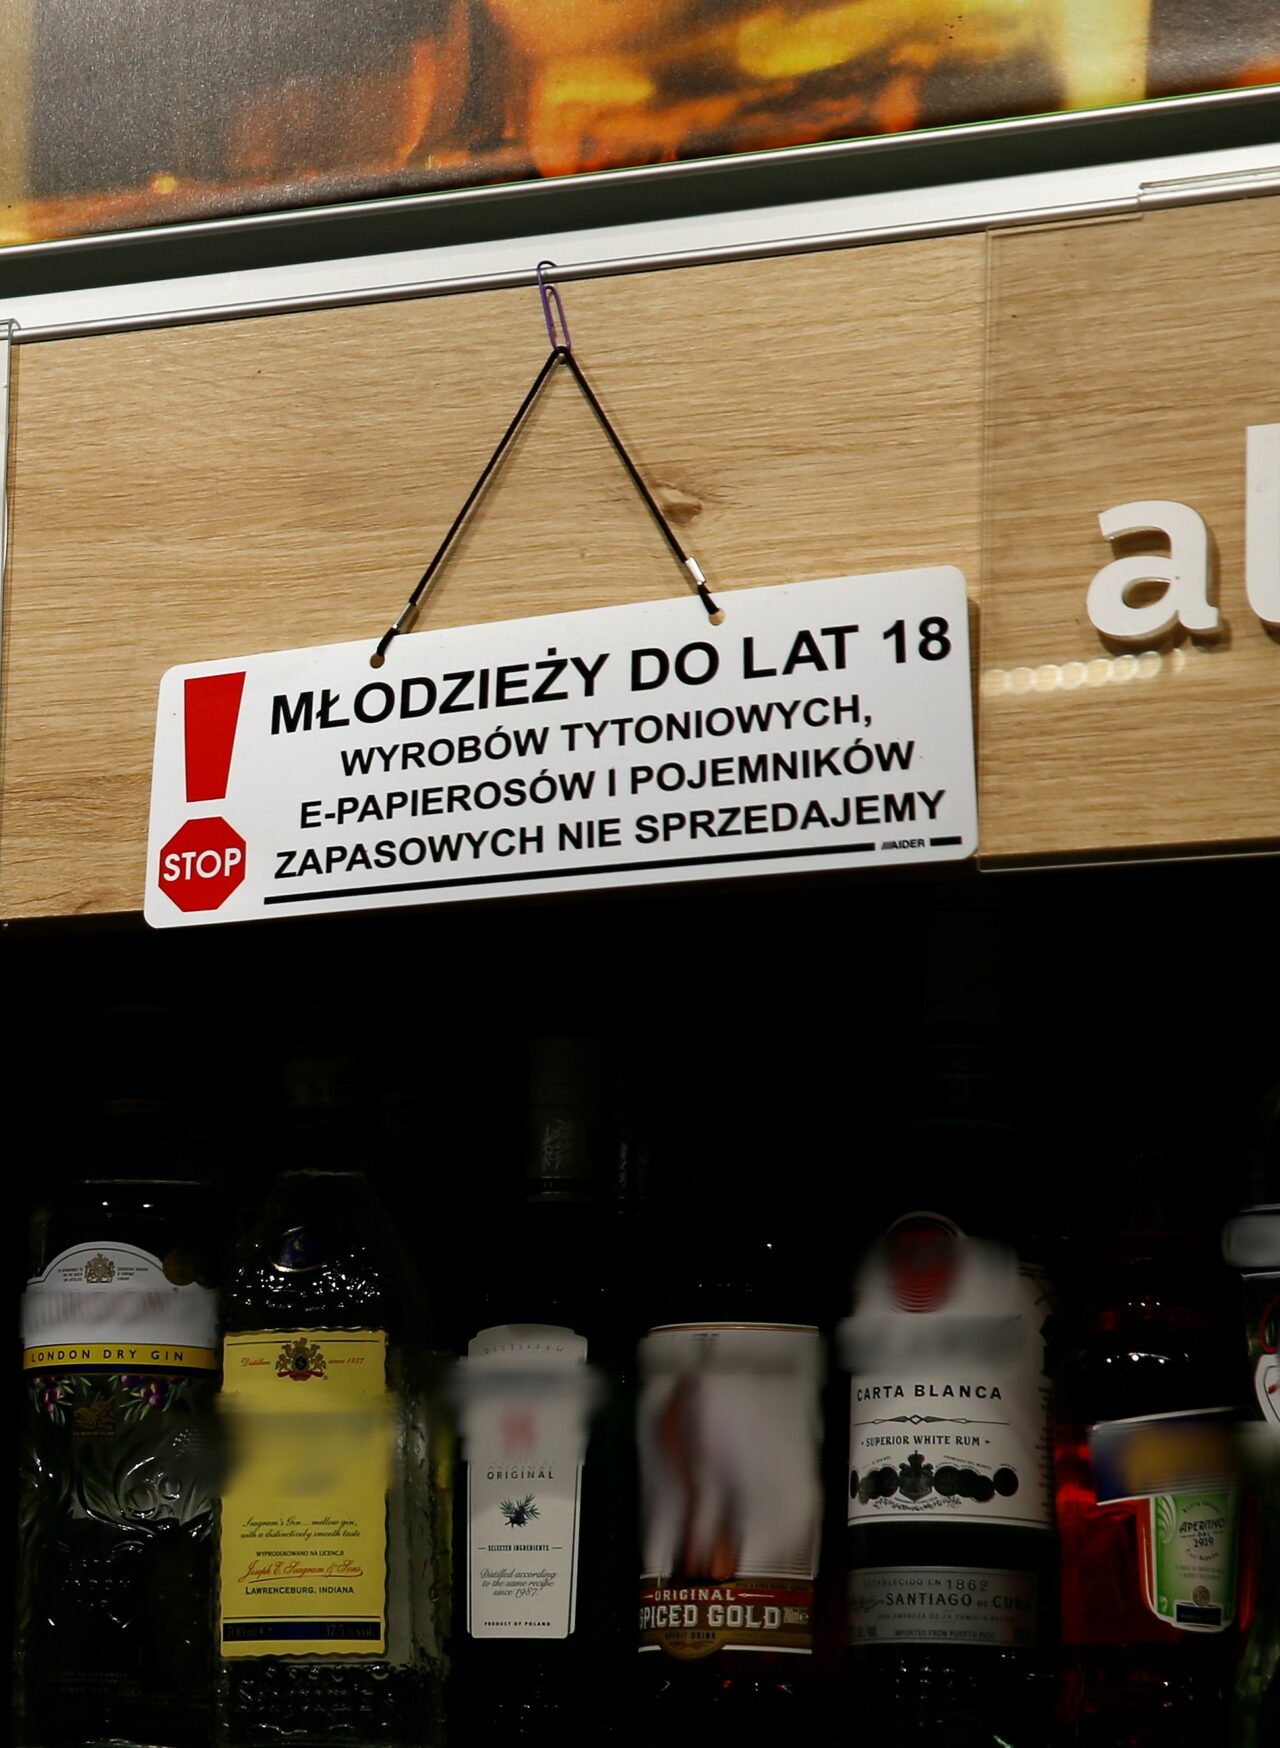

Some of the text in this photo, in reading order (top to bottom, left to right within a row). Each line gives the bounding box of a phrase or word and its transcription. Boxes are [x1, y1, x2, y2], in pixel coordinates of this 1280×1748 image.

[271, 615, 952, 736] MŁODZIEŻY DO LAT 18
[341, 693, 873, 778] WYROBÓW TYTONIOWYCH,
[301, 739, 916, 829] E-PAPIEROSÓW I POJEMNIKÓW
[163, 789, 945, 884] STOP ZAPASOWYCH NIE SPRZEDAJEMY
[31, 1350, 184, 1363] LONDON DRY GIN
[857, 1384, 1002, 1402] CARTA BLANCA
[865, 1434, 980, 1447] SUPERIOR WHITE RUM
[487, 1470, 555, 1480] ORIGINAL
[265, 1528, 312, 1541] distinctively
[314, 1528, 341, 1538] smooth
[342, 1528, 361, 1538] taste
[488, 1544, 550, 1552] SELECTED INGREDIENTS
[514, 1568, 557, 1580] according
[245, 1586, 355, 1596] LAWRENCEBURG, INDIANA
[928, 1578, 942, 1586] EN
[946, 1579, 989, 1591] 1862
[654, 1588, 737, 1602] ORIGINAL
[886, 1592, 972, 1607] SANTIAGO
[639, 1604, 699, 1630] SPICED
[707, 1604, 782, 1630] GOLD
[927, 1629, 948, 1638] FROM
